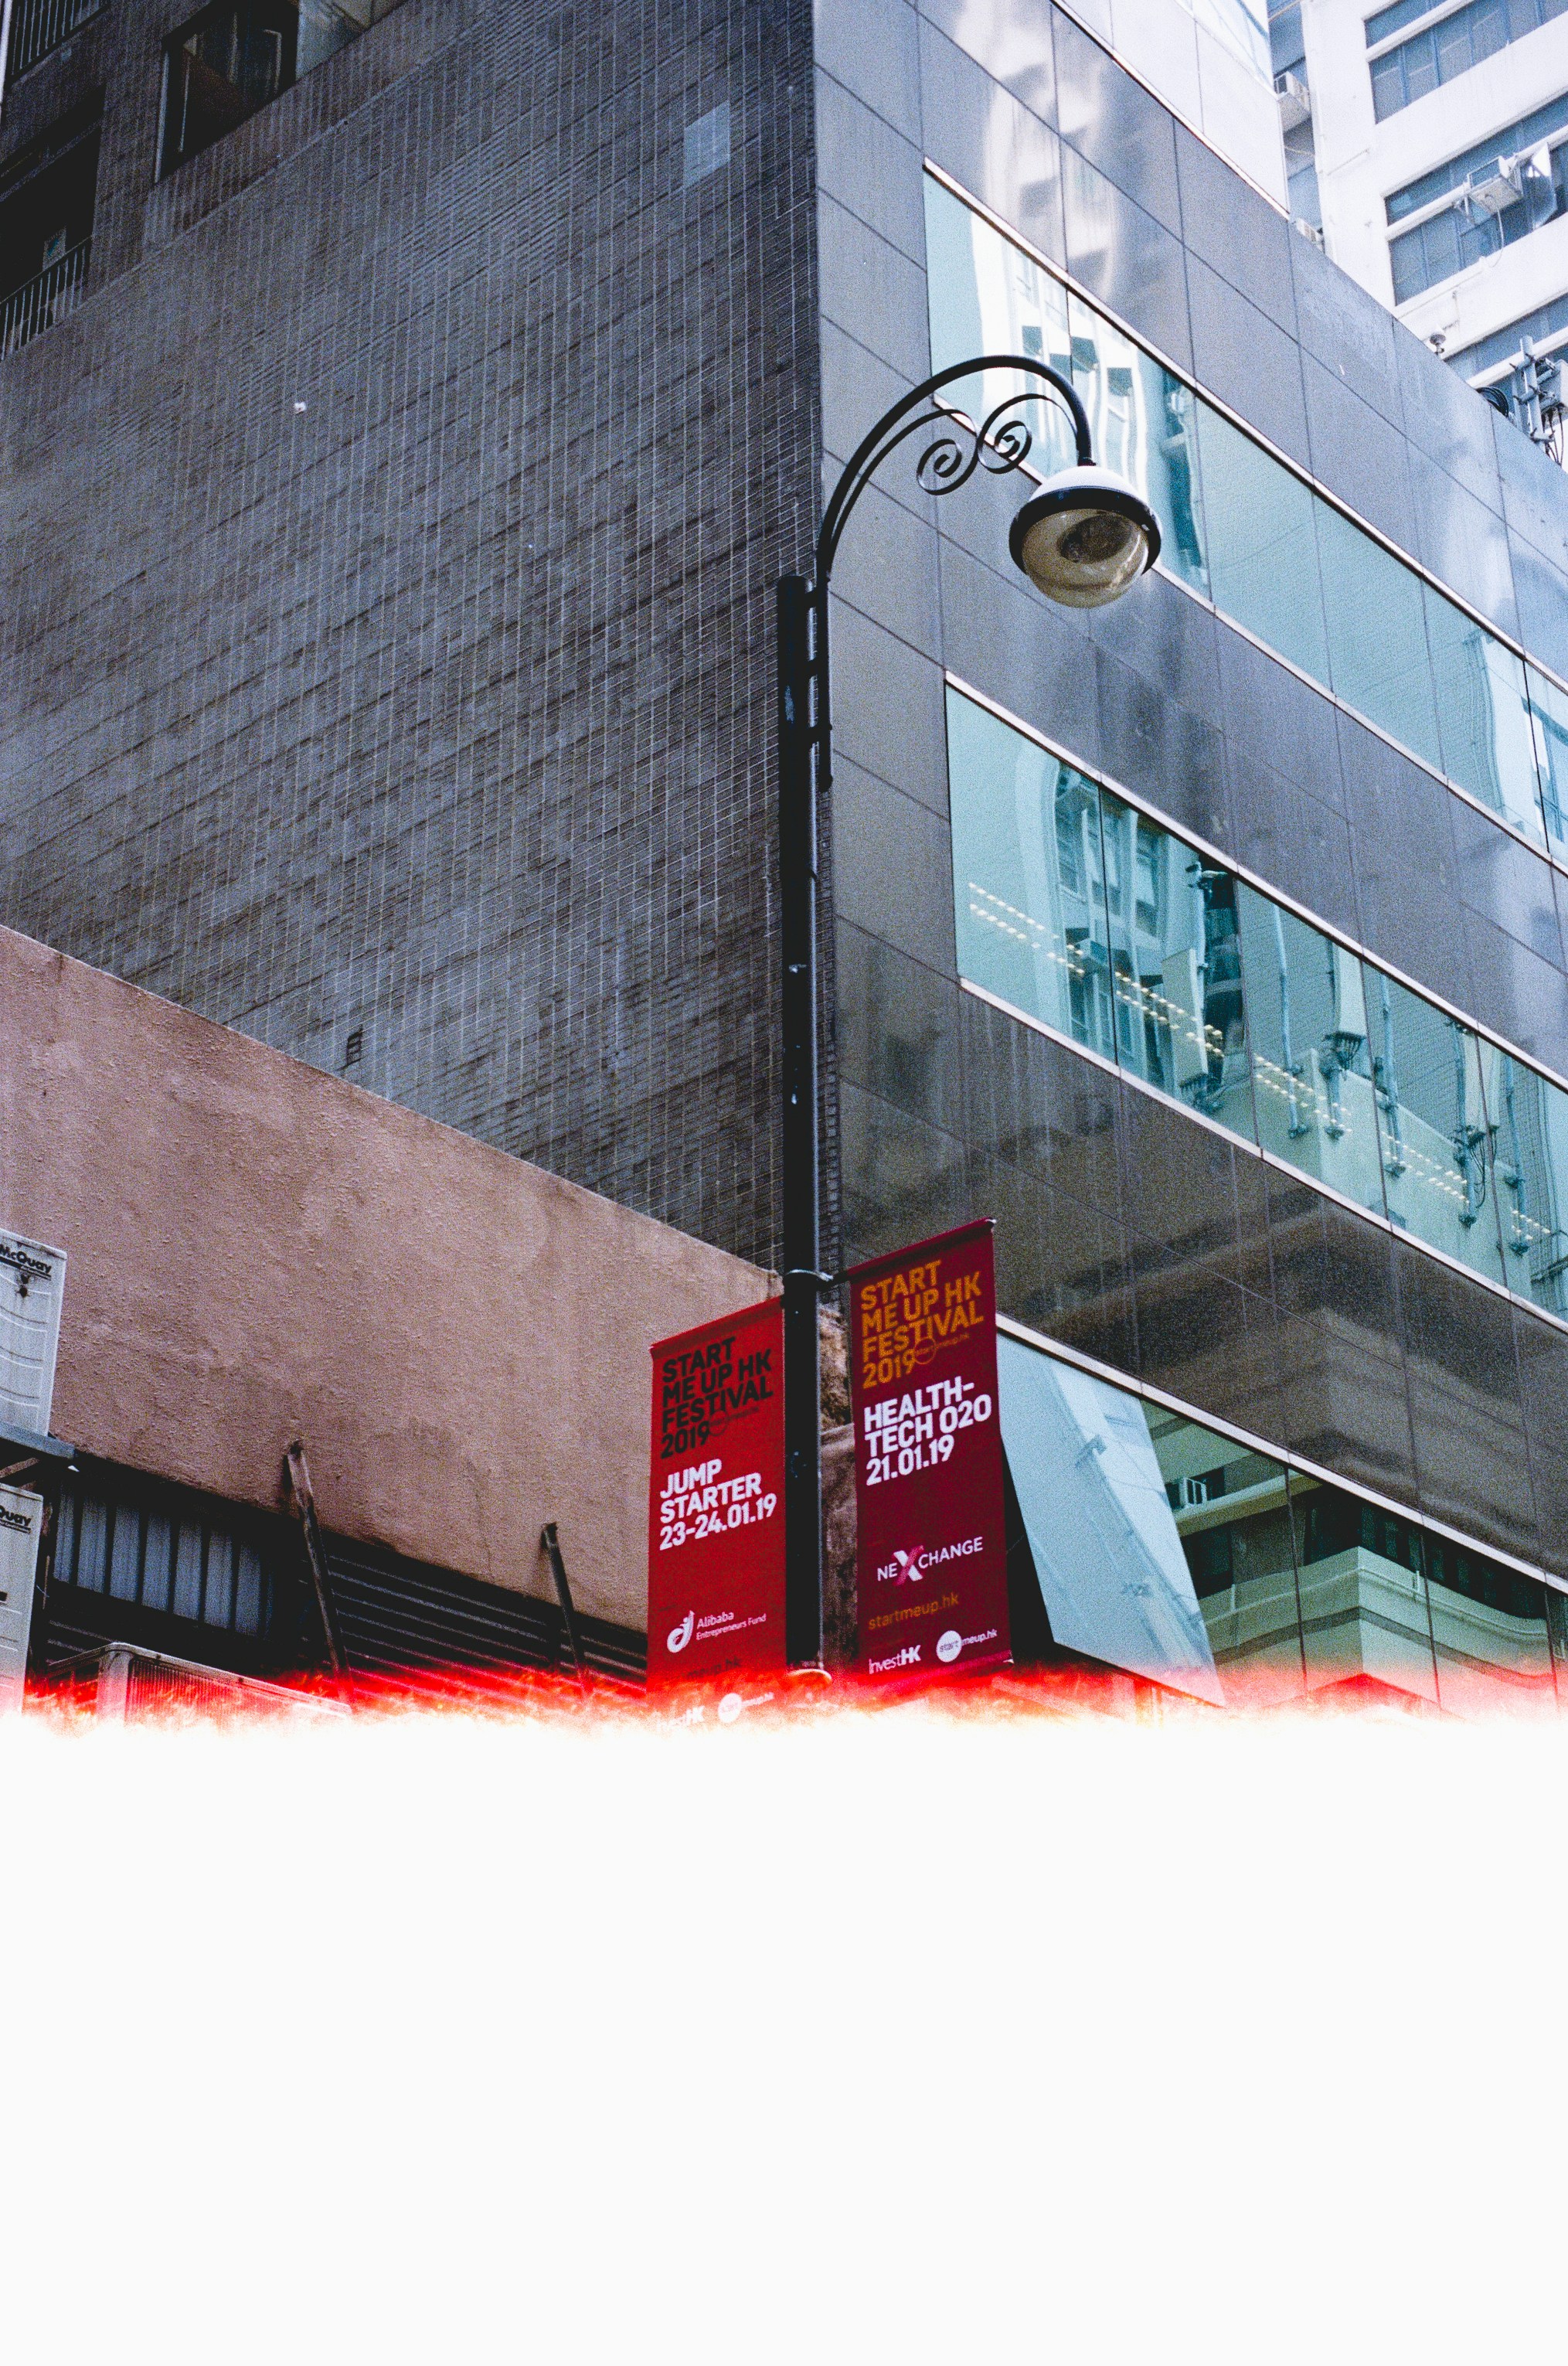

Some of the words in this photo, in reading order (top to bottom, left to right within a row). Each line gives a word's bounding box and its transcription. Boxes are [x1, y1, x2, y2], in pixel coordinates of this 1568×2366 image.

[861, 1259, 941, 1311] START
[862, 1302, 898, 1337] ME
[903, 1289, 939, 1321] UP
[944, 1271, 981, 1307] HK
[862, 1300, 984, 1363] FESTIVAL
[662, 1336, 736, 1382] START
[662, 1376, 696, 1408] ME
[701, 1363, 733, 1393] UP
[739, 1349, 771, 1381] HK
[862, 1348, 916, 1389] 2019
[662, 1376, 774, 1433] FESTIVAL
[864, 1376, 974, 1432] HEALTH-
[661, 1421, 710, 1459] 2019
[864, 1412, 934, 1458] TECH
[660, 1459, 722, 1499] JUMP
[866, 1434, 954, 1486] 21.01.19
[660, 1472, 762, 1523] STARTER
[659, 1493, 777, 1551] 23-24.01.19
[696, 1621, 747, 1640] Entrepreneurs
[748, 1613, 767, 1626] Fund
[697, 1612, 734, 1629] Alibaba
[869, 1592, 959, 1630] startmeup.hk
[869, 1645, 921, 1674] InvestHK
